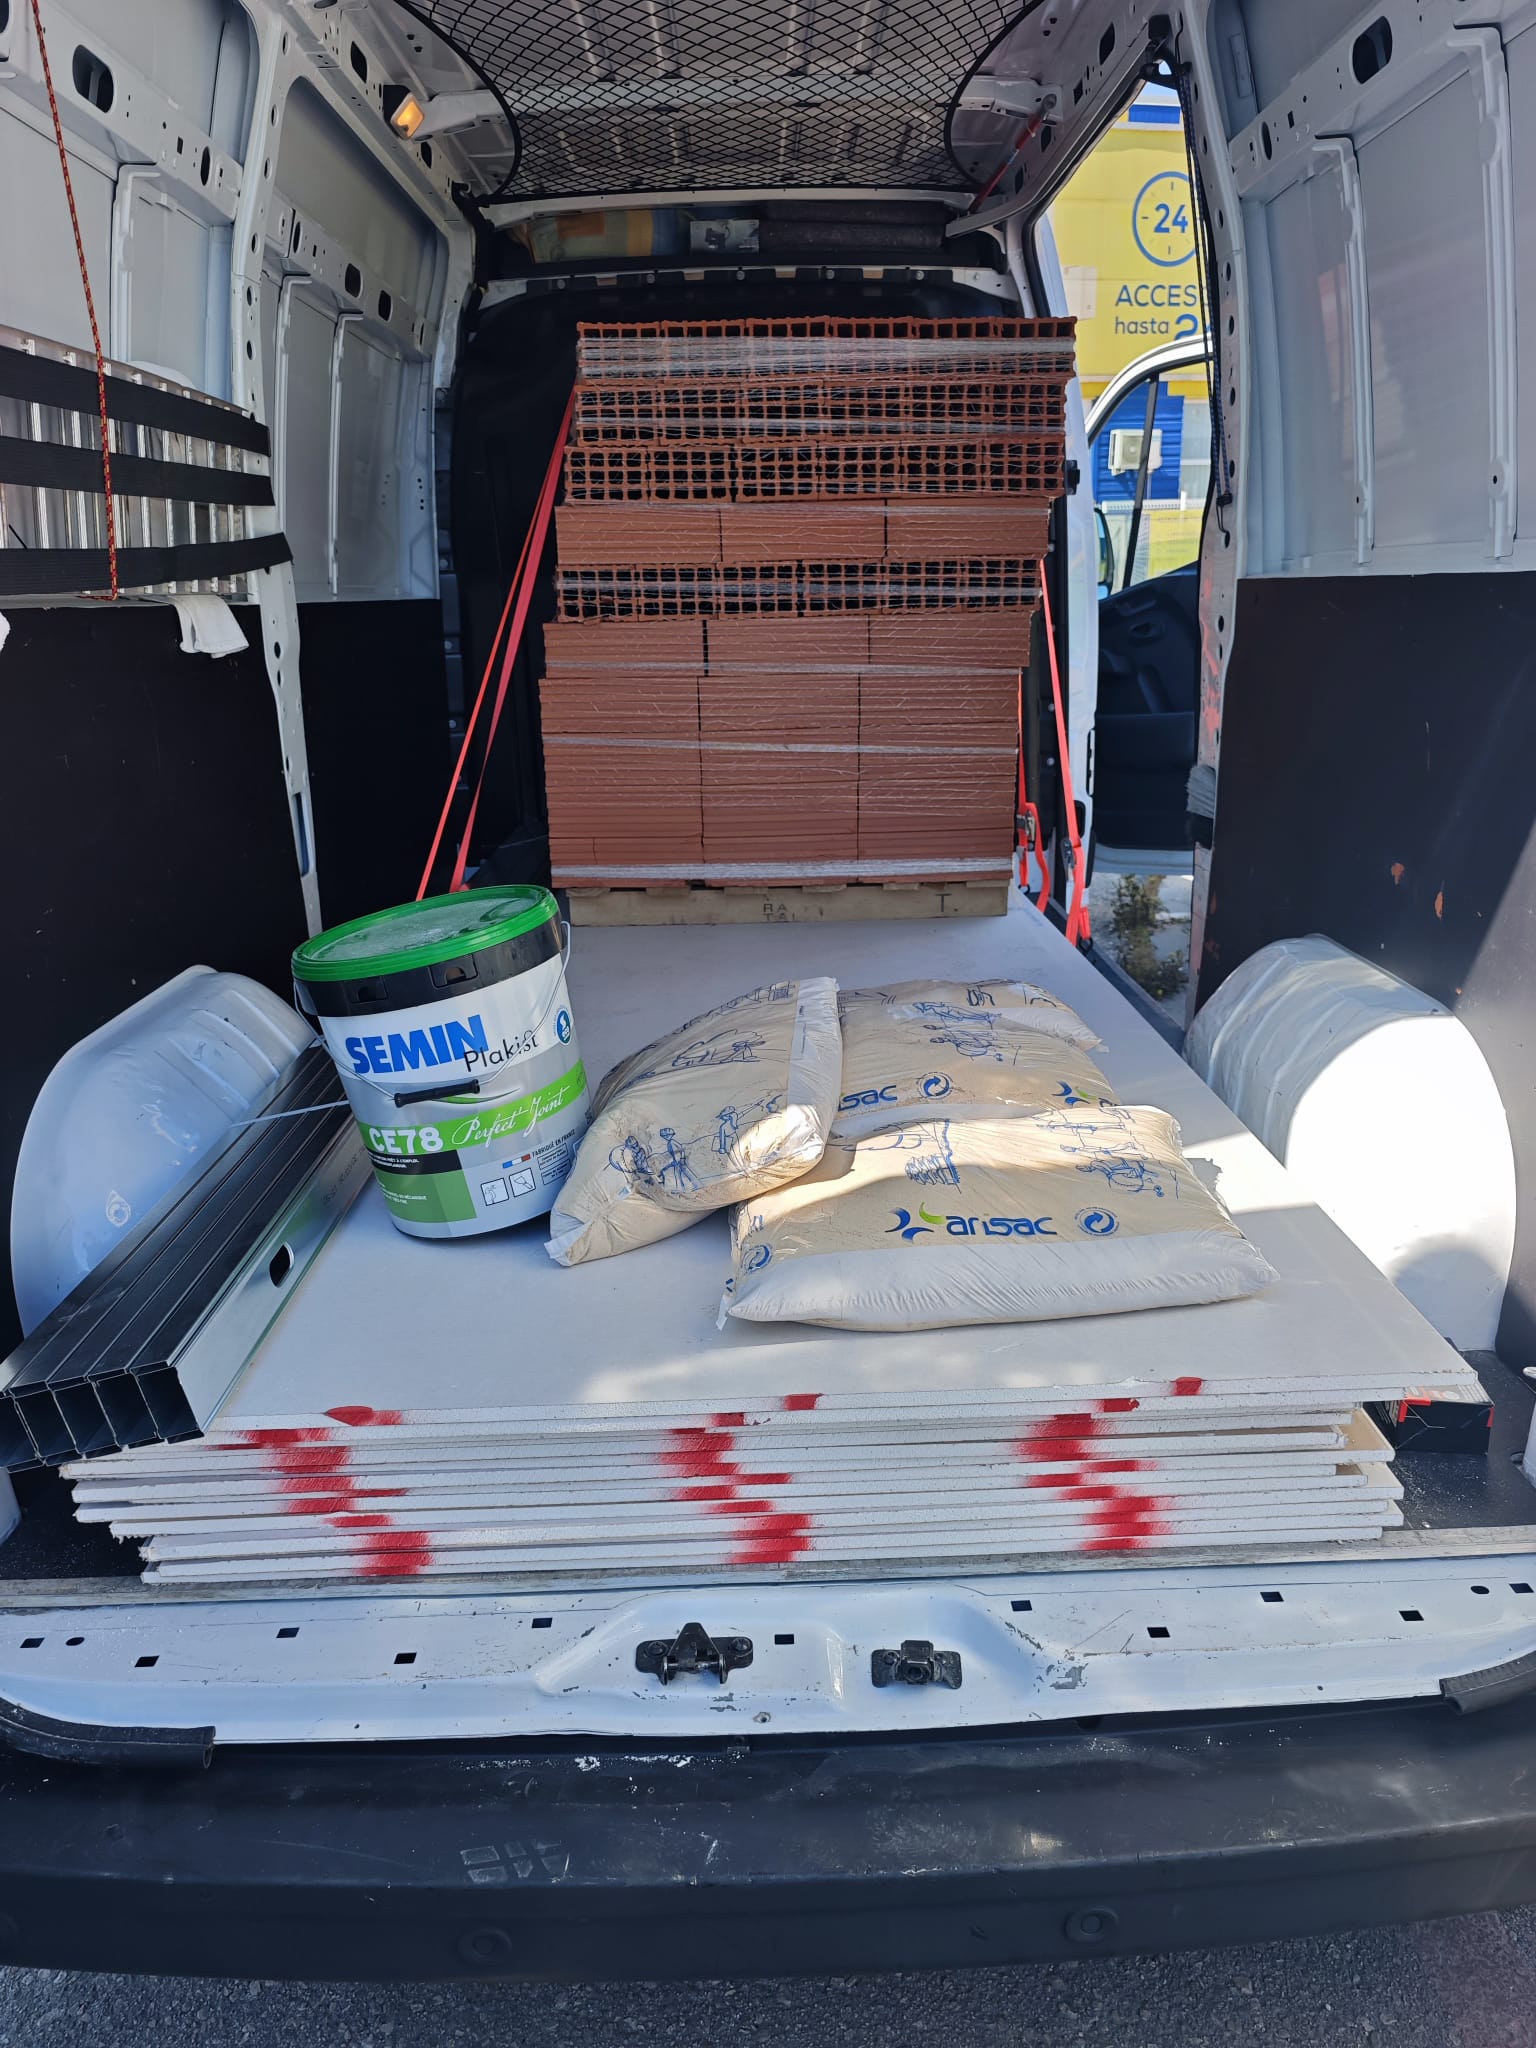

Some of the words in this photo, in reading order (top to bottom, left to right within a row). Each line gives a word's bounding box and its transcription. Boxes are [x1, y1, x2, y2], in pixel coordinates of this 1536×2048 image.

[1154, 203, 1188, 234] 24
[1115, 284, 1207, 307] ACCES
[1114, 317, 1170, 335] hasta
[345, 1014, 489, 1074] SEMIN
[451, 1106, 529, 1148] Perfect
[523, 1085, 571, 1137] Joint
[368, 1126, 444, 1154] CE78
[945, 1214, 1058, 1237] arisac
